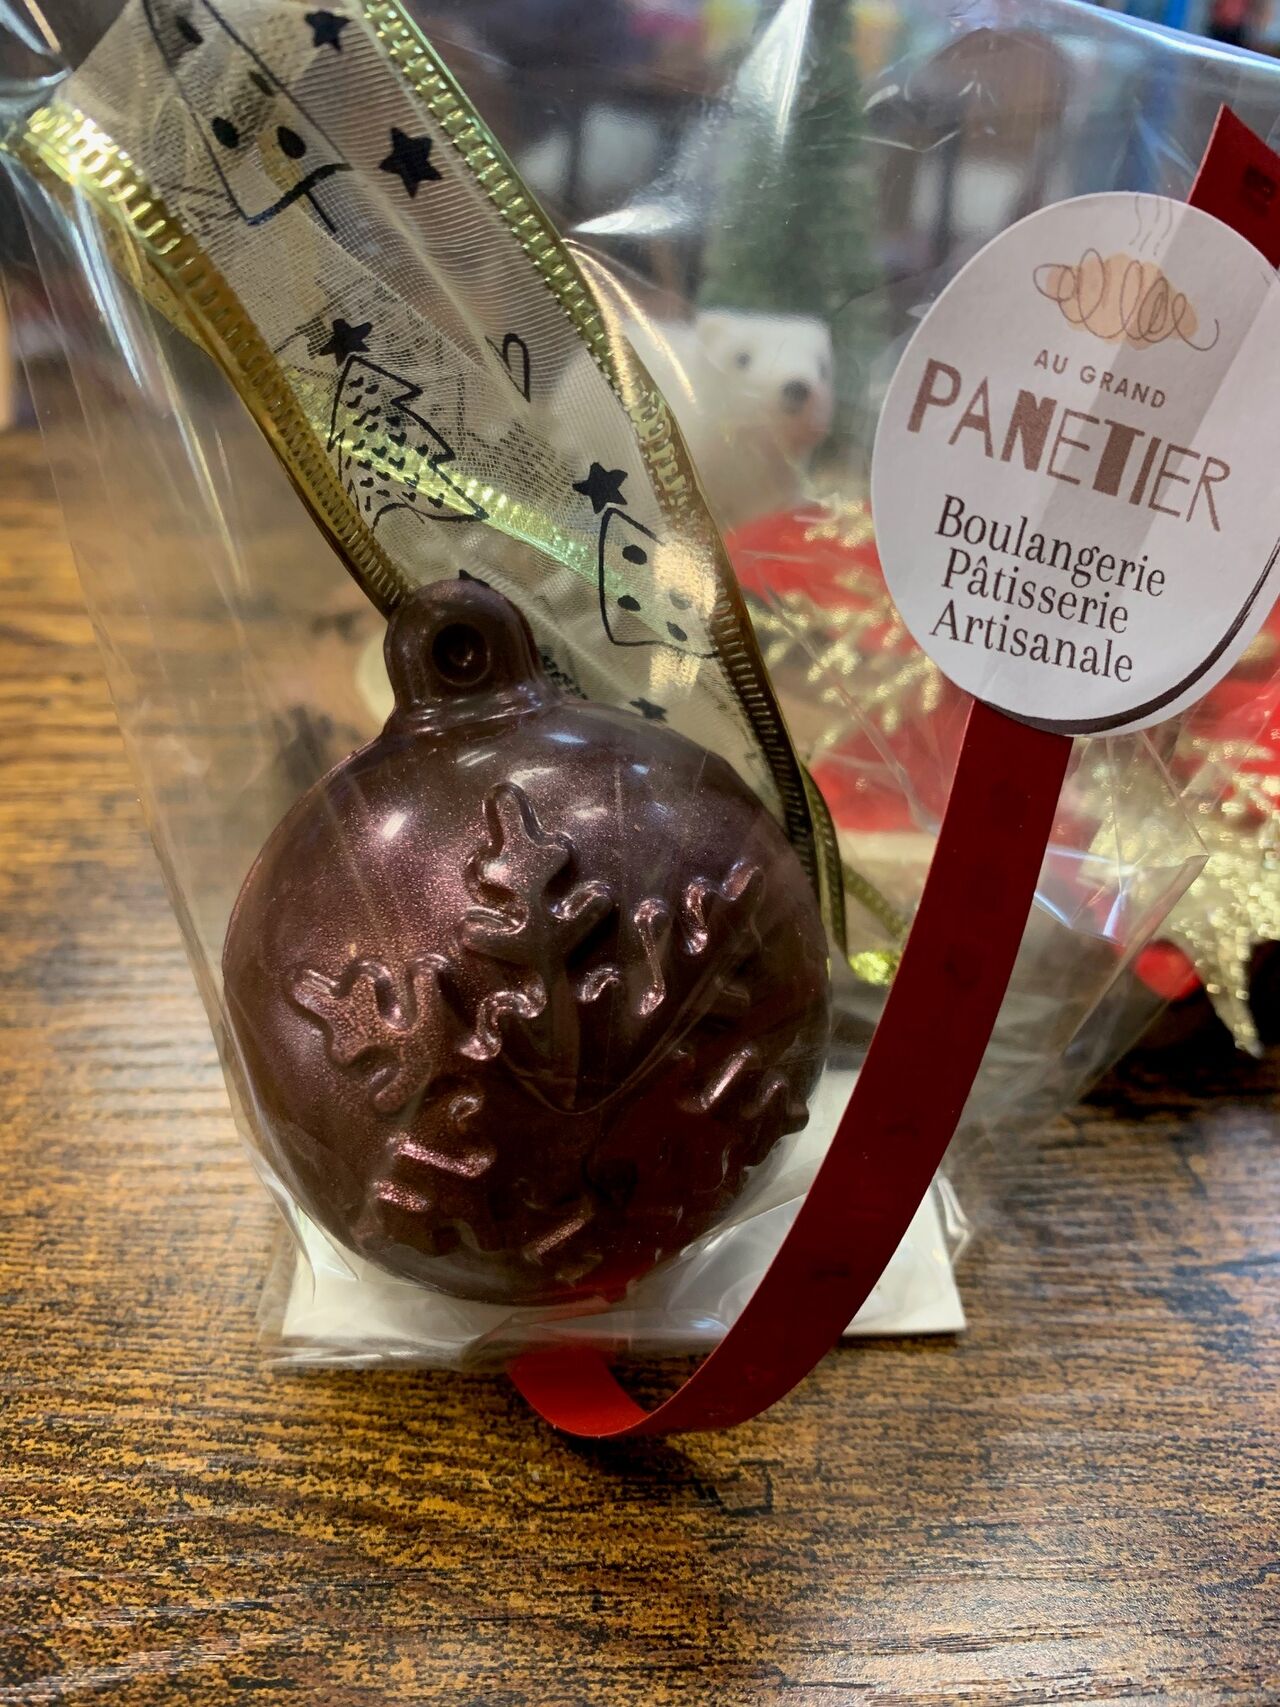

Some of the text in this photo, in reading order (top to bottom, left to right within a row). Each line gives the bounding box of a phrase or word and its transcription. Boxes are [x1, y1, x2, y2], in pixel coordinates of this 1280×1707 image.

[1034, 350, 1166, 409] AU GRAND
[907, 359, 1231, 532] PANETIER
[936, 495, 1166, 598] Boulangerie
[941, 548, 1129, 634] Pâtisserie
[930, 600, 1134, 683] Artisanale
